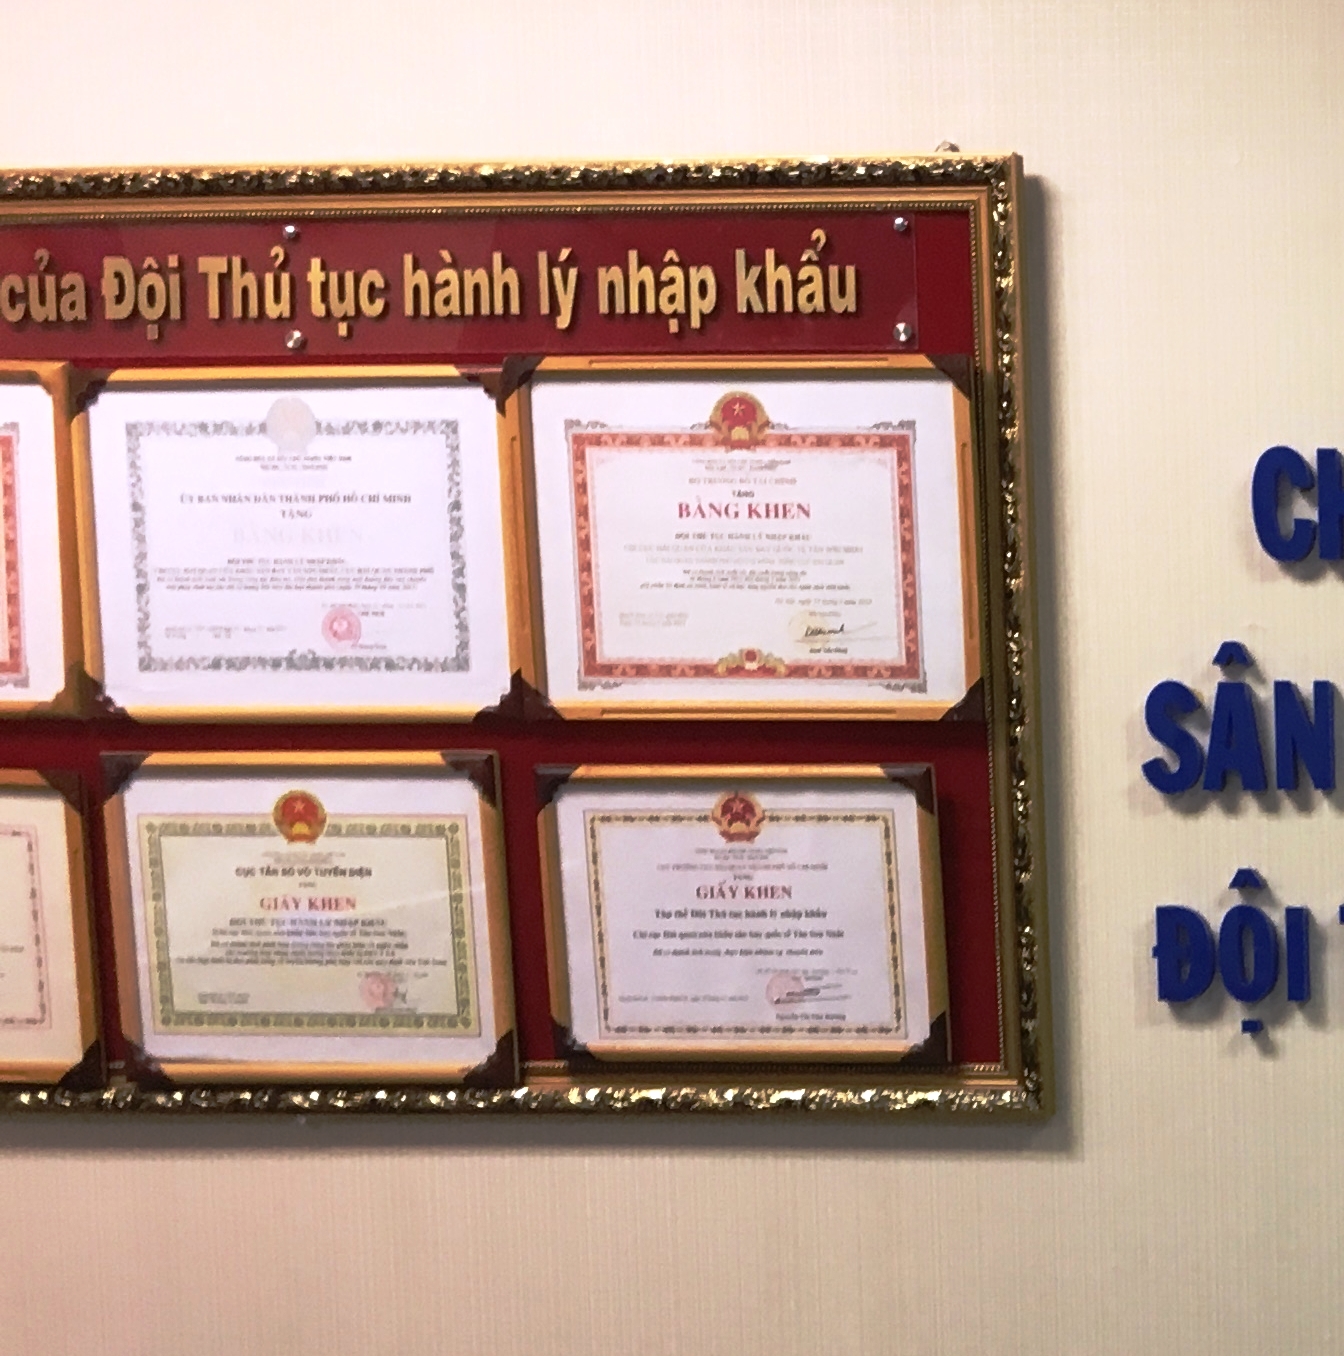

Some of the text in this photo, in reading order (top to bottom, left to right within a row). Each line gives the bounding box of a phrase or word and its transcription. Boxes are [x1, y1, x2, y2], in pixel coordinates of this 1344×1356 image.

[0, 229, 858, 340] của Đội Thủ tục hành lý nhập khẩu
[748, 503, 811, 520] KHEN
[1144, 643, 1333, 793] SÂN
[308, 896, 357, 912] KHEN
[744, 884, 793, 900] KHEN
[1153, 870, 1308, 1031] ĐỘI
